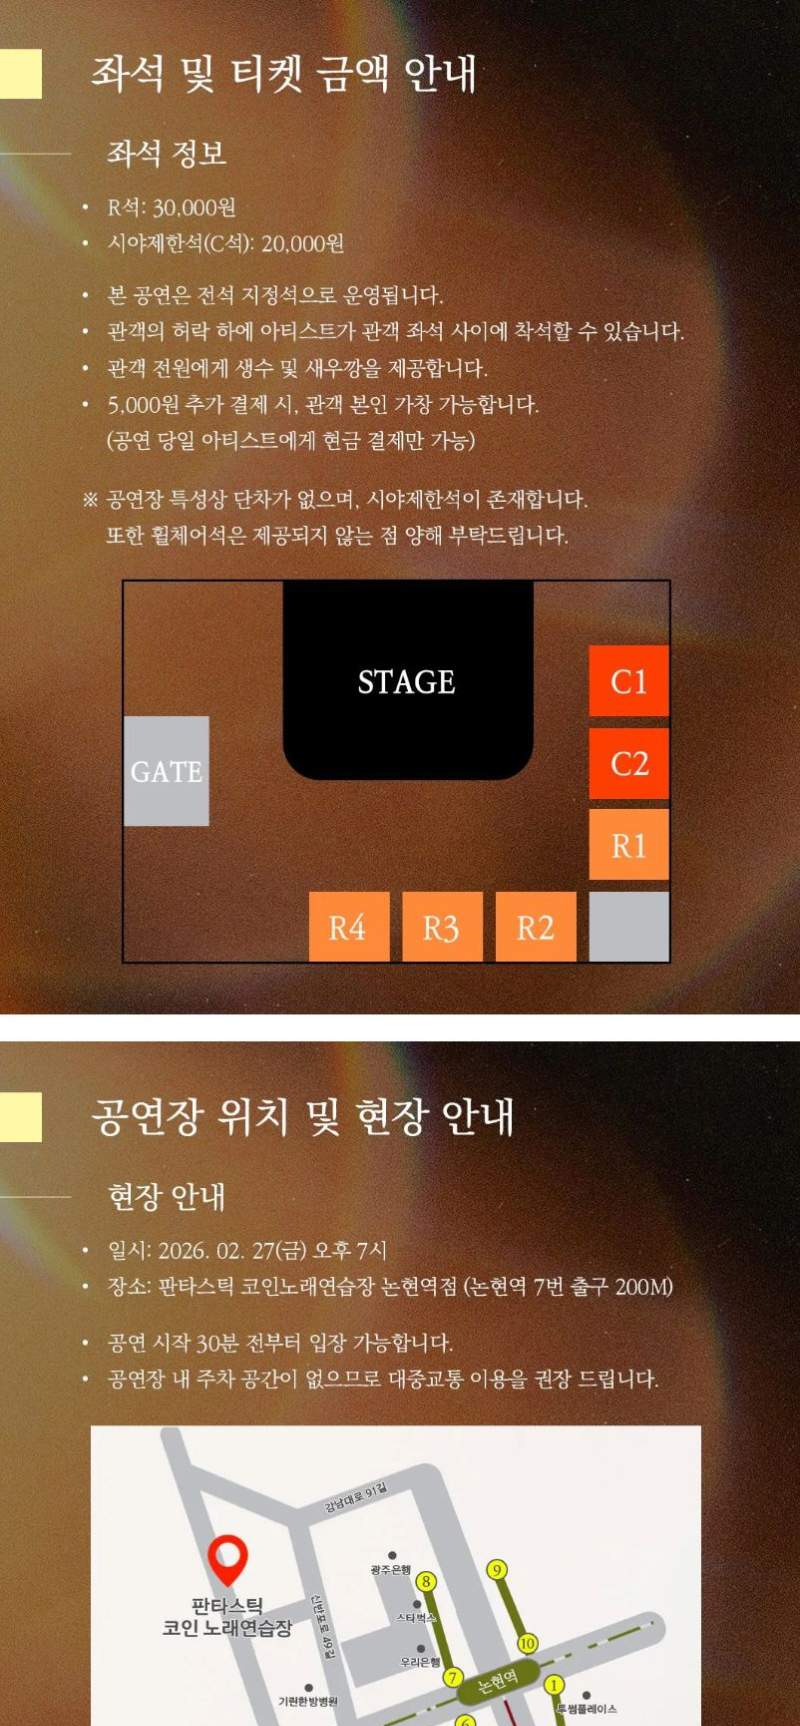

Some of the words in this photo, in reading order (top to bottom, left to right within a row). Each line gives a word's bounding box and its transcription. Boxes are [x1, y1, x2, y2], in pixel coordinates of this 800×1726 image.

[90, 53, 163, 95] 좌석
[180, 53, 214, 94] 및
[230, 53, 302, 94] 티켓
[315, 53, 388, 95] 금액
[404, 53, 476, 95] 안내
[107, 138, 161, 170] 좌석
[172, 138, 228, 170] 정보
[108, 196, 146, 218] R석:
[152, 196, 236, 219] 30,000원
[107, 232, 254, 255] 시야제한석(C석):
[261, 232, 345, 254] 20,000원
[107, 284, 128, 306] 본
[132, 284, 192, 306] 공연은
[197, 284, 234, 306] 전석
[241, 284, 338, 306] 지정석으로
[342, 284, 444, 307] 운영됩니다.
[107, 357, 146, 379] 관객
[152, 357, 229, 379] 전원에게
[235, 357, 275, 379] 생수
[279, 357, 298, 379] 및
[305, 357, 383, 380] 새우깡을
[387, 357, 488, 380] 제공합니다.
[358, 669, 456, 695] STAGE
[611, 668, 647, 695] C1
[131, 760, 203, 783] GATE
[611, 751, 650, 777] C2
[611, 833, 646, 859] R1
[328, 912, 366, 941] R4
[423, 914, 460, 944] R3
[517, 914, 555, 941] R2
[91, 1096, 206, 1137] 공연장
[217, 1096, 287, 1138] 위치
[306, 1096, 340, 1138] 및
[354, 1096, 431, 1137] 현장
[442, 1096, 514, 1138] 안내
[107, 1182, 164, 1213] 현장
[171, 1182, 225, 1213] 안내
[108, 1240, 152, 1261] 일시:
[158, 1241, 210, 1260] 2026.
[216, 1241, 245, 1260] 02.
[252, 1239, 307, 1262] 27(금)
[311, 1240, 352, 1262] 오후
[356, 1240, 386, 1262] 7시
[108, 1276, 152, 1298] 장소:
[158, 1276, 234, 1297] 판타스틱
[240, 1276, 376, 1298] 코인노래연습장
[380, 1275, 457, 1298] 논현역점
[463, 1275, 526, 1298] (논현역
[533, 1275, 565, 1297] 7번
[569, 1276, 610, 1298] 출구
[615, 1275, 674, 1298] 200M)
[370, 1564, 411, 1576] 광주은행
[191, 1597, 263, 1616] 판타스틱
[396, 1612, 437, 1623] 스타벅스
[162, 1619, 199, 1638] 코인
[203, 1619, 293, 1638] 노래연습장
[400, 1656, 441, 1669] 우리은행
[477, 1668, 519, 1696] 논현역
